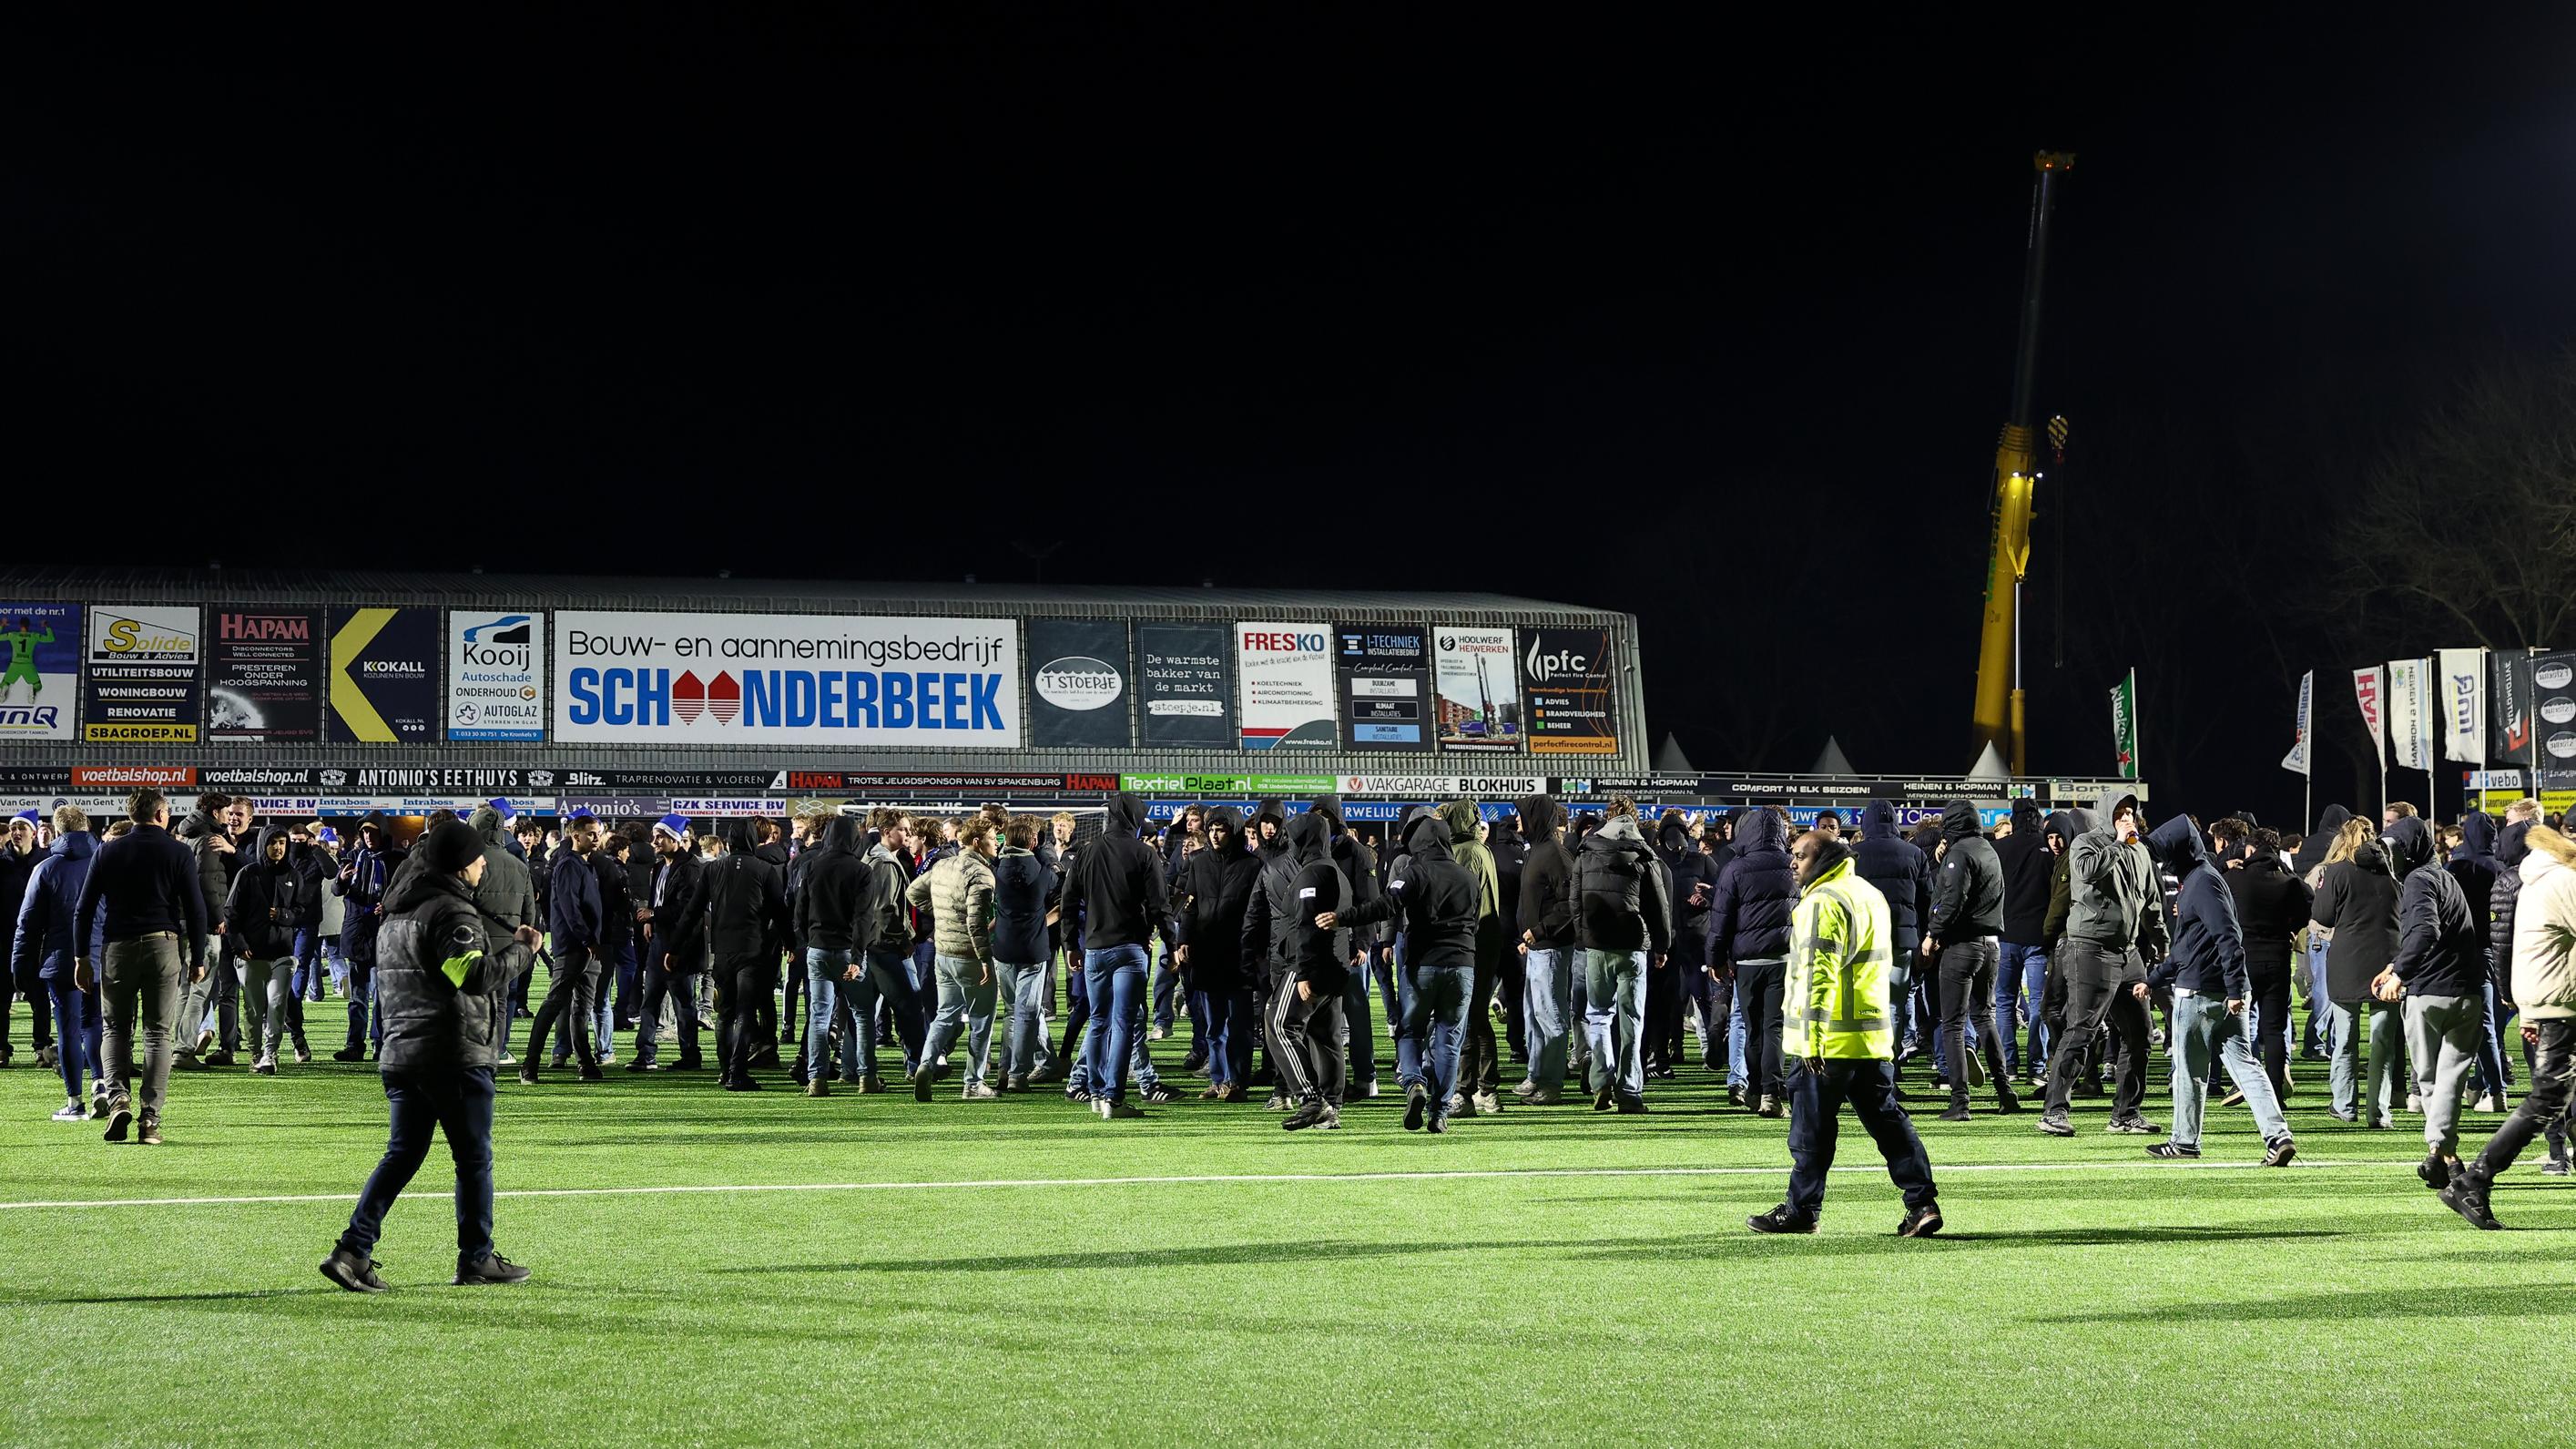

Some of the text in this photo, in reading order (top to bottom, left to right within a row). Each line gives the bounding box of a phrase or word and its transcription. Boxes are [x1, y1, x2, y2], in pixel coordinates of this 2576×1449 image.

[35, 607, 46, 615] de
[49, 607, 65, 616] nr.1
[103, 619, 190, 652] Solide
[1459, 636, 1503, 644] HOOLWERF
[18, 638, 26, 652] 1
[1244, 633, 1324, 652] FRESKO
[1367, 635, 1420, 648] I-TECHNIEK
[569, 630, 1003, 668] Bouw- en aannemingsbedrijf
[1368, 648, 1420, 656] INSTALLATIEBEDRIJF
[1459, 645, 1508, 653] HEIWERKEN
[154, 652, 188, 660] Advies
[463, 643, 530, 671] Kooij
[1146, 654, 1220, 666] De warmste
[1543, 649, 1586, 681] pfc
[92, 668, 194, 678] UTILITEITSBOUW
[462, 672, 532, 682] Autoschade
[1146, 668, 1221, 679] bakker van
[98, 688, 187, 697] WONINGBOUW
[455, 688, 517, 698] ONDERHOUD
[1155, 682, 1214, 693] de markt
[107, 708, 176, 717] RENOVATIE
[484, 705, 537, 717] AUTOGLAZ
[1154, 702, 1217, 713] stoepje.nl
[90, 728, 192, 738] SBAGROEP.NL
[1533, 740, 1613, 749] perfectfirecontrol.nl
[81, 768, 187, 785] voetbalshop.nl
[205, 770, 309, 786] voetbalshop.nl
[358, 770, 439, 786] ANTONIO'S
[443, 770, 518, 786] EETHUYS
[565, 771, 606, 786] Blitz.
[616, 775, 700, 784] TRAPRENOVATIE
[716, 776, 765, 784] VLOEREN
[848, 777, 883, 785] TROTSE
[997, 778, 1061, 786] SPAKENBURG
[2490, 772, 2519, 787] vebo
[1124, 776, 1253, 791] TextielPlaat.nl
[1366, 778, 1535, 792] VAKGARAGE BLOKHUIS
[1732, 783, 1783, 792] COMFORT
[1799, 785, 1819, 793] ELK
[1822, 786, 1870, 794] SEIZOEN!
[1957, 783, 2001, 791] HOPMAN
[2058, 784, 2111, 792] Bort
[296, 800, 316, 808] BV
[673, 801, 785, 810] GZK SERVICE BV
